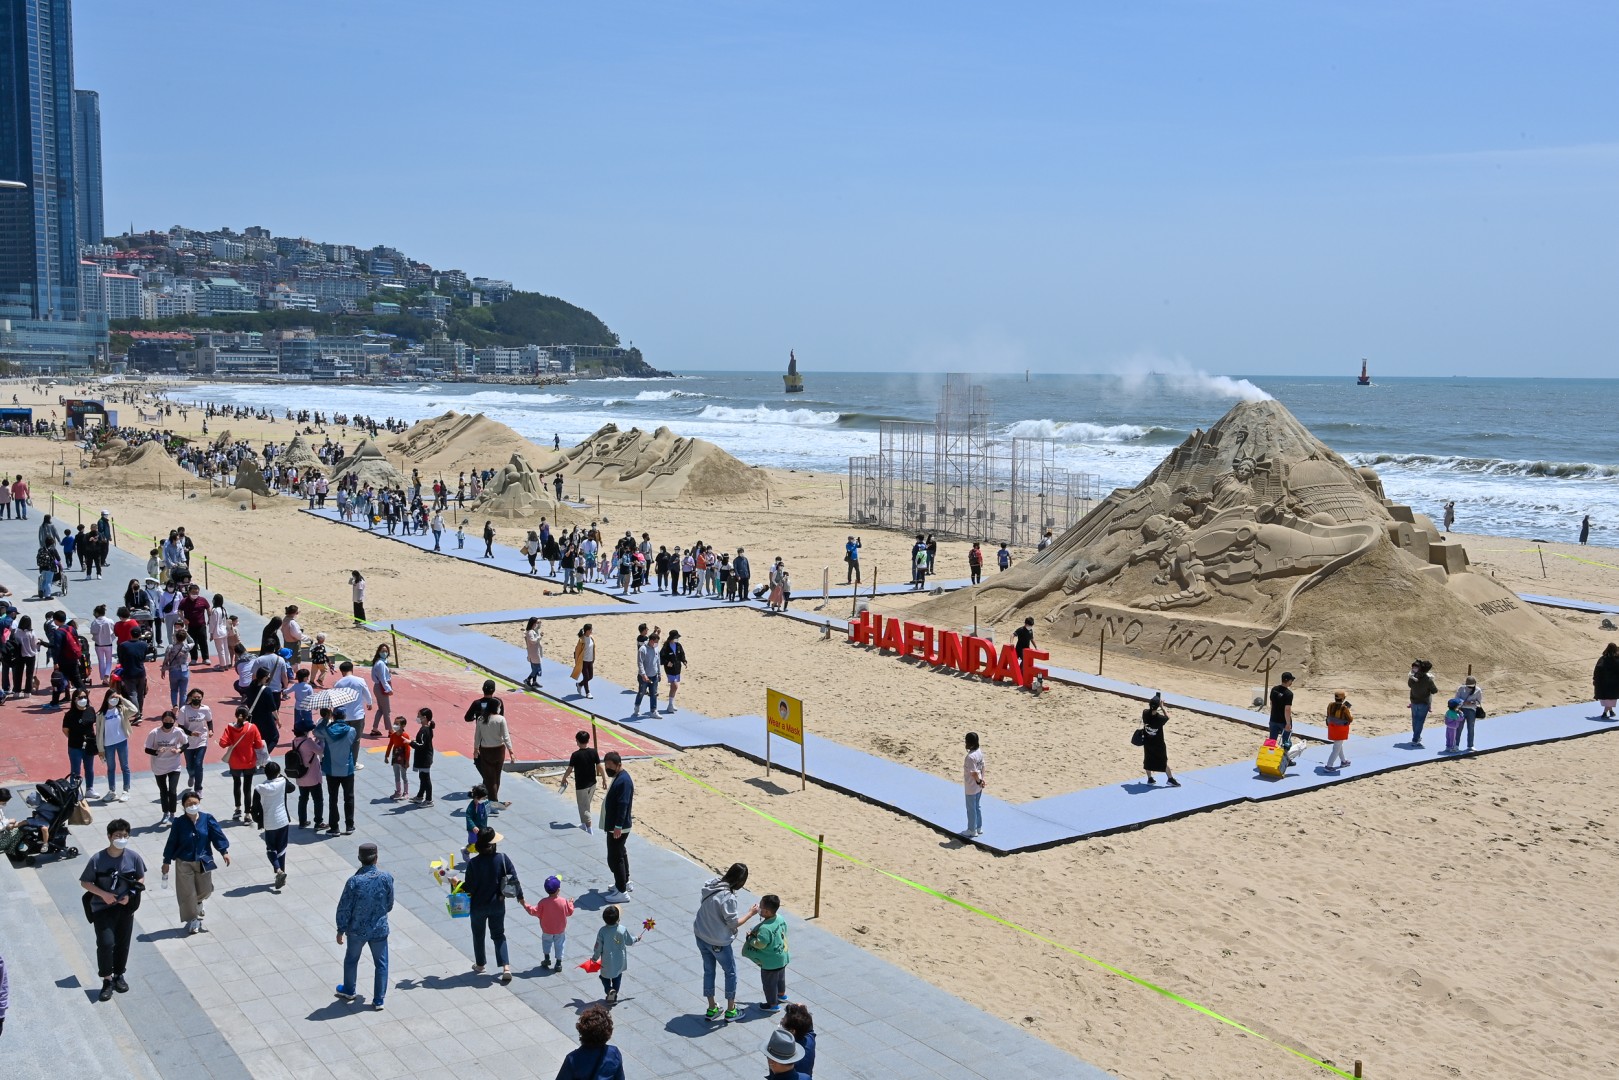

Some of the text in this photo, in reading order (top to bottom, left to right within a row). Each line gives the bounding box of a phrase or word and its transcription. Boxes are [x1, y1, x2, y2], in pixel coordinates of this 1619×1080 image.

[1160, 624, 1282, 673] WORLD
[768, 716, 781, 728] Wear
[786, 723, 801, 736] Mask
